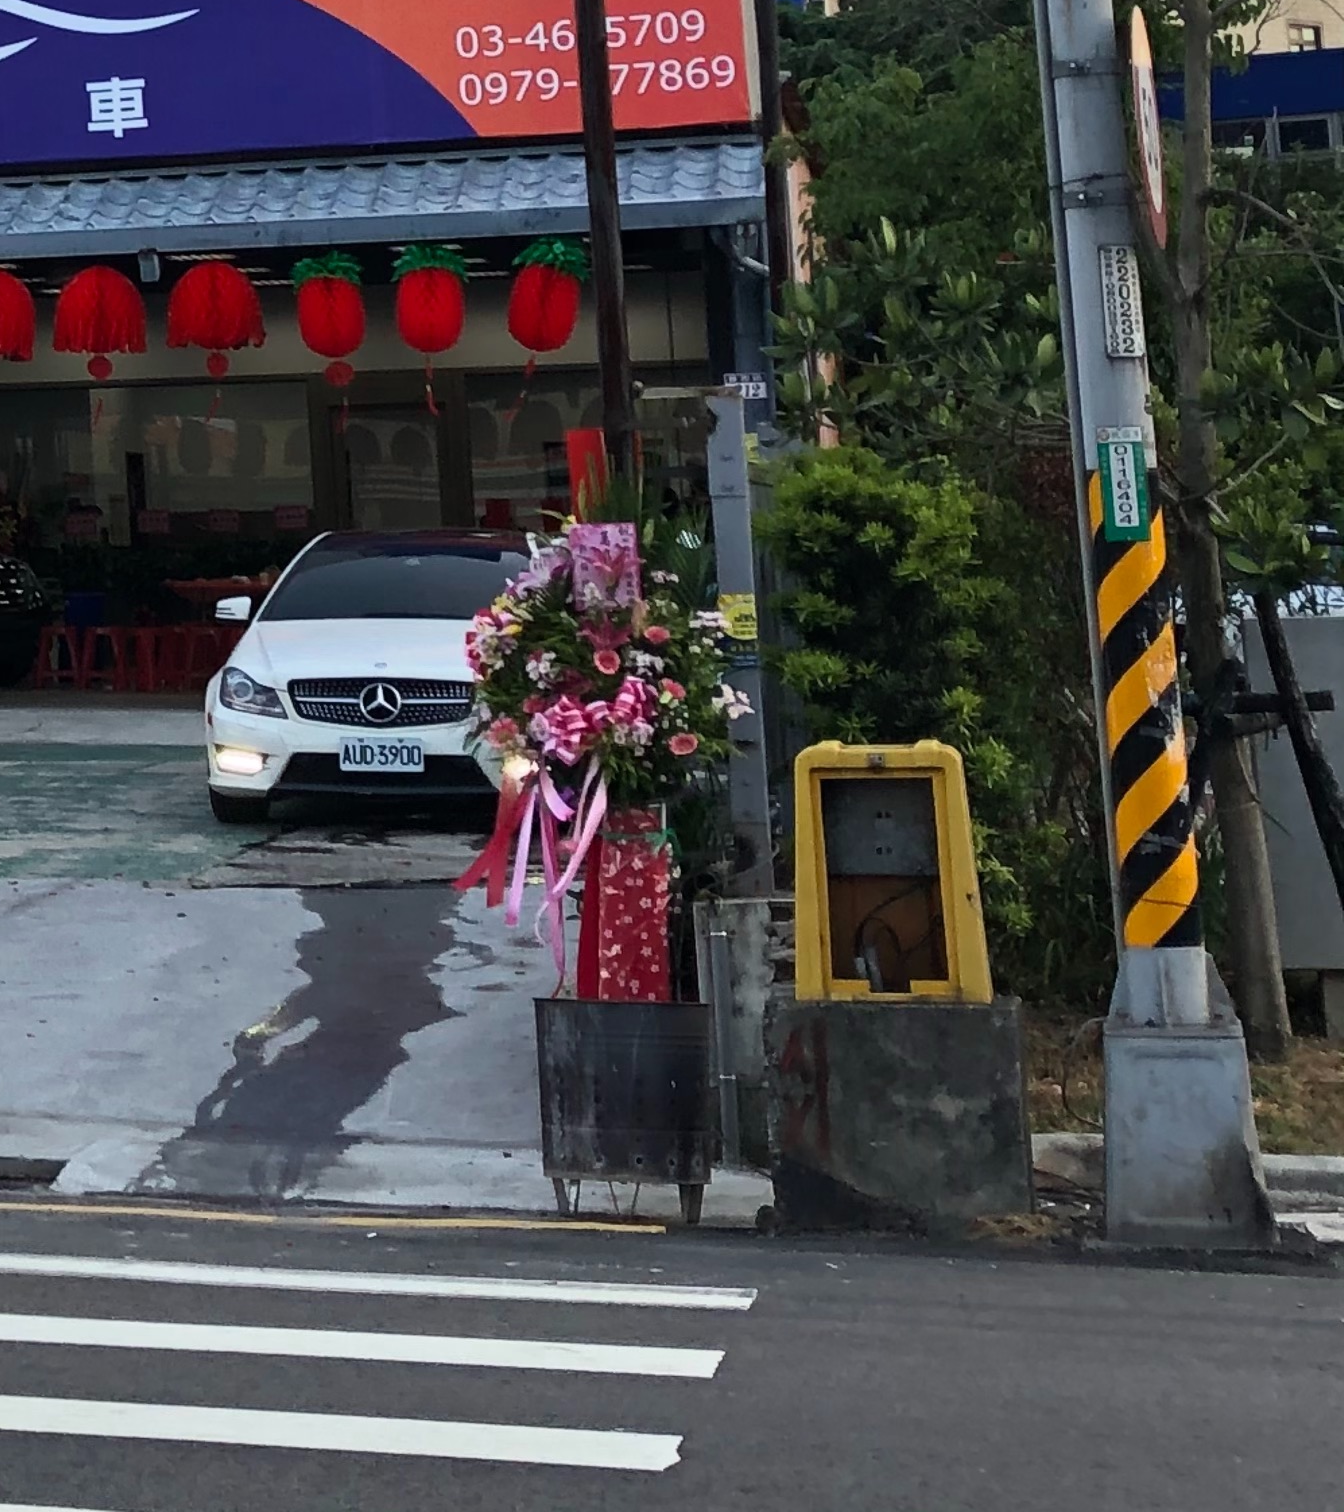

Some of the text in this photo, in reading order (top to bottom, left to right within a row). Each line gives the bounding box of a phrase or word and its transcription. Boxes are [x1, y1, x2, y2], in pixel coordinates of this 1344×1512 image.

[455, 9, 706, 59] 03-465709
[459, 54, 736, 106] 0979-77869
[1116, 247, 1135, 354] 220232
[1114, 444, 1133, 525] 0116404
[342, 744, 422, 766] AUD-3900
